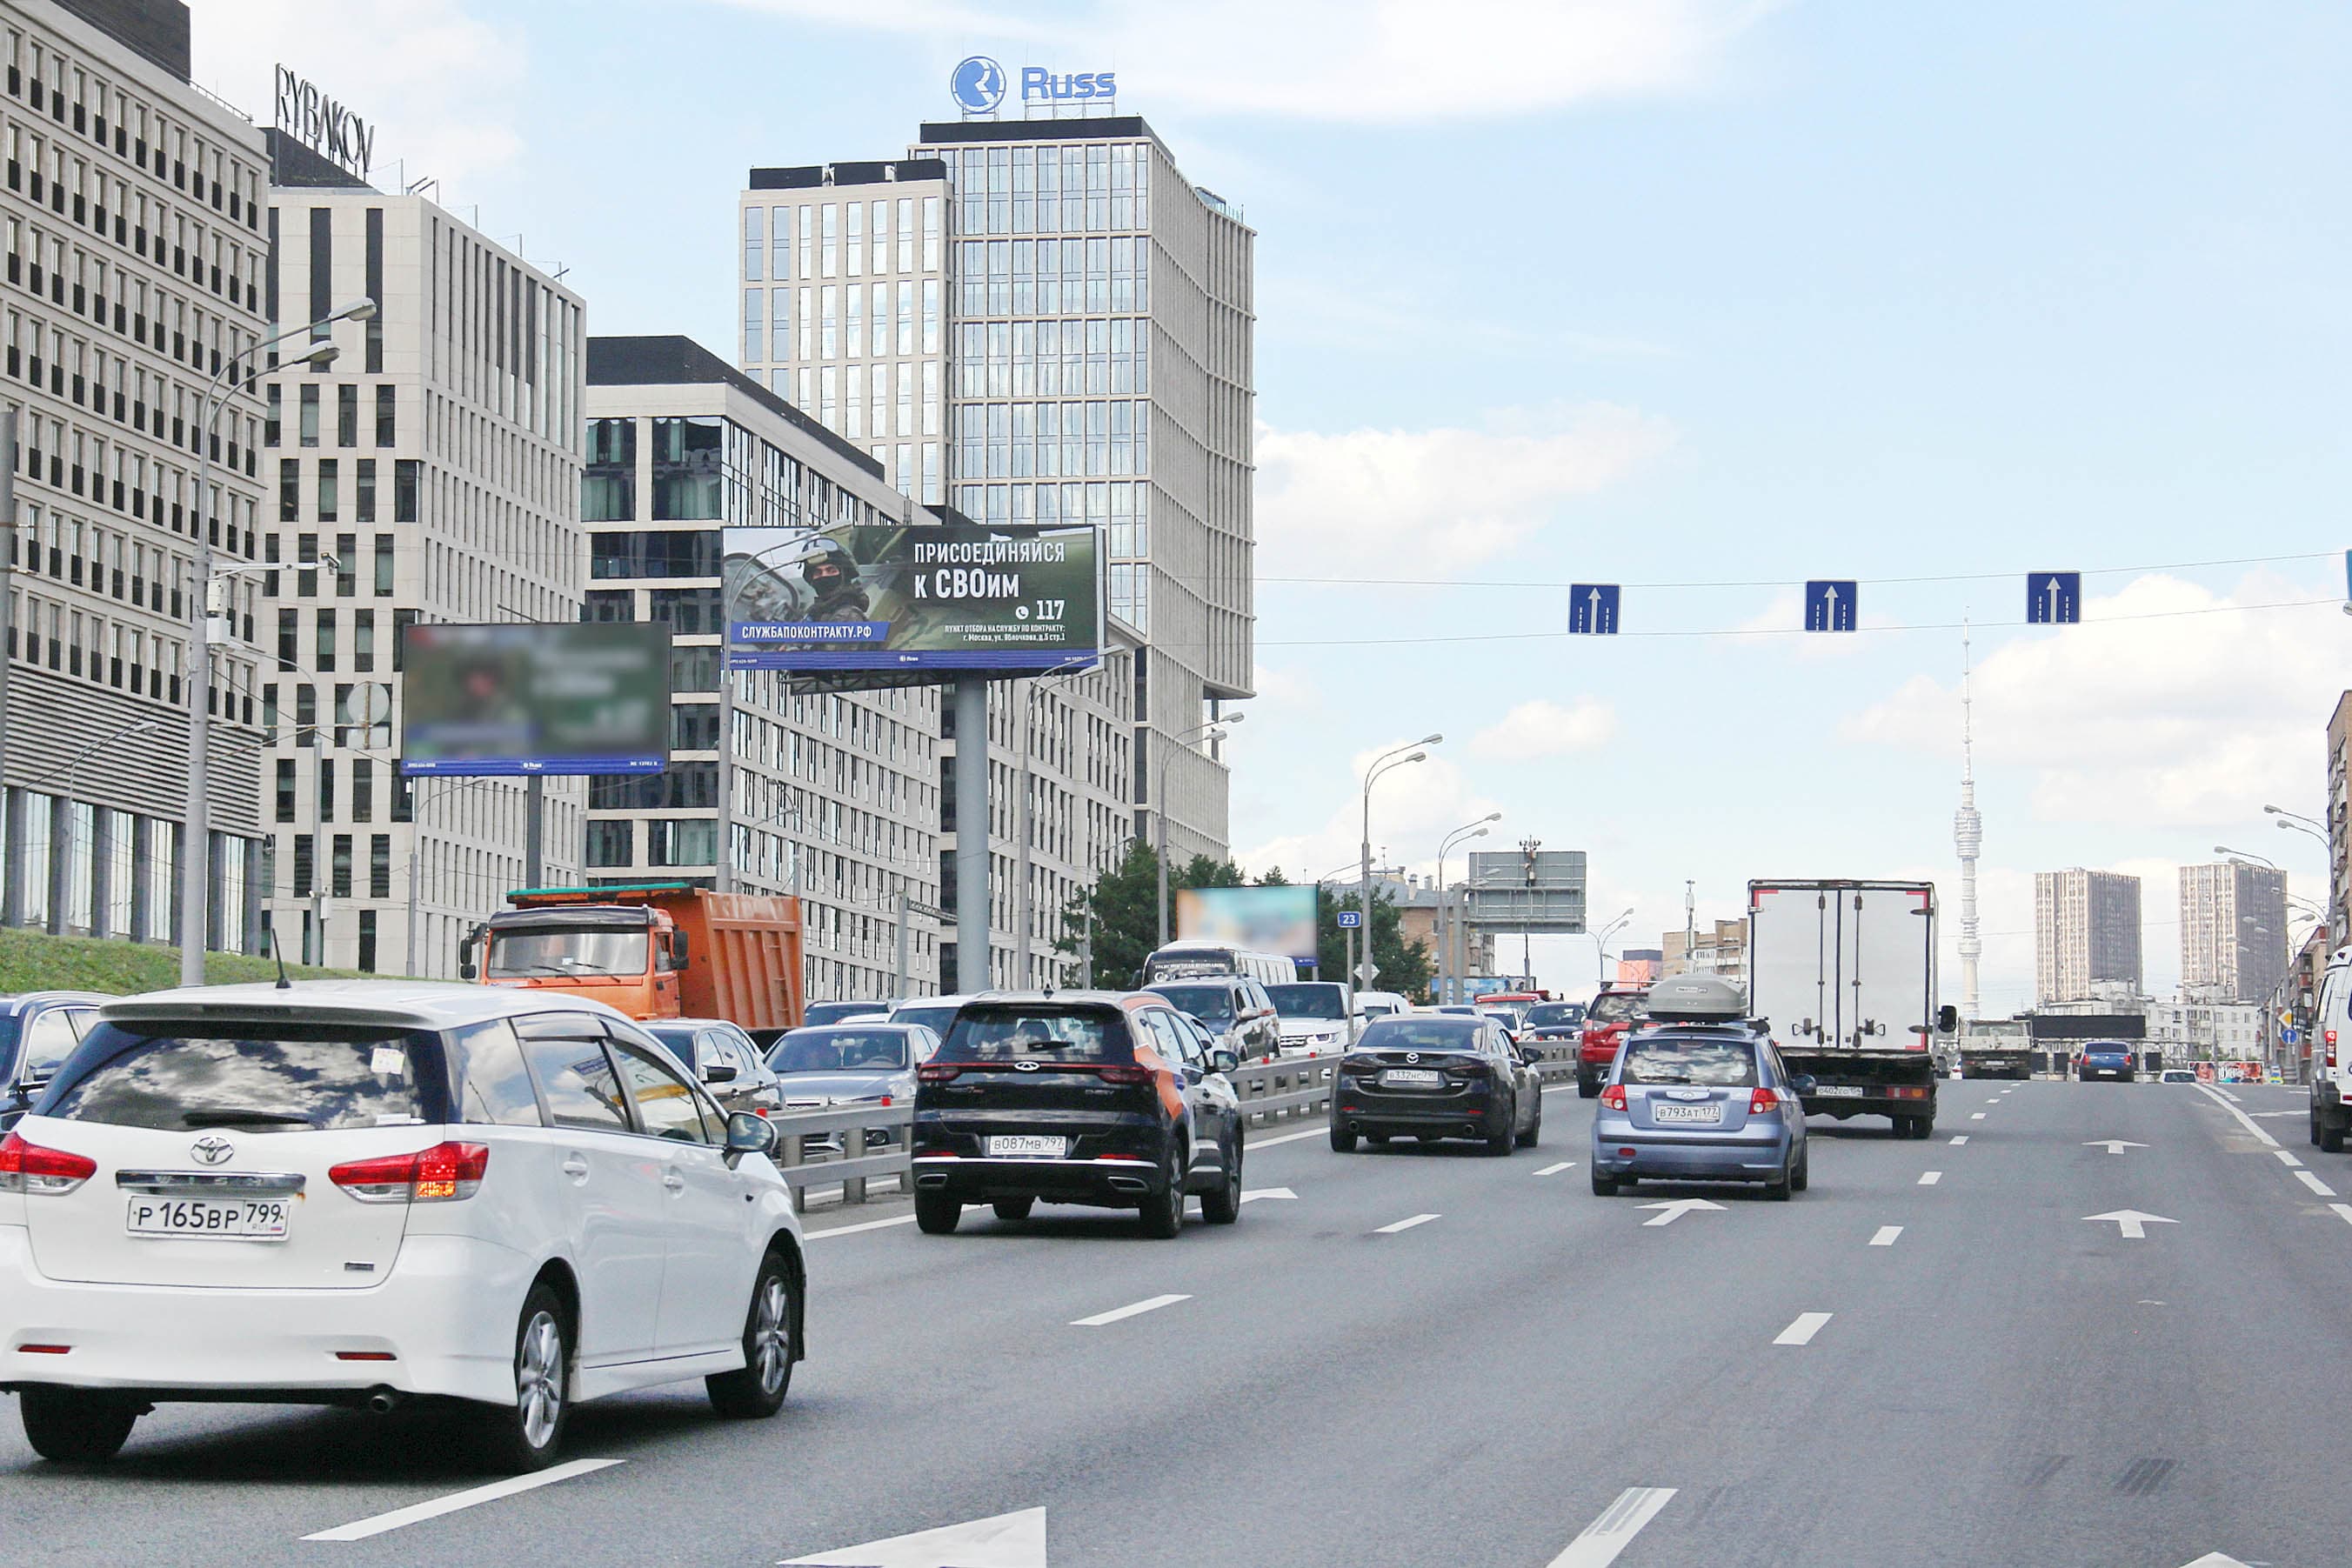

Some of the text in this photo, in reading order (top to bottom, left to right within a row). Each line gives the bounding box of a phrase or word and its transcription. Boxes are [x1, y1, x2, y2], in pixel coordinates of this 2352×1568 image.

[1021, 66, 1117, 100] Russ
[275, 63, 375, 172] RYBAKOV
[914, 538, 1065, 565] ПРИСОЕДИНЯЙСЯ
[1036, 599, 1066, 620] 117
[742, 625, 872, 639] СЛУЖБАПОКОНТРАКТУ.РФ
[965, 624, 986, 633] ОТБОРА
[987, 624, 996, 633] НА
[996, 624, 1021, 633] СЛУЖБУ
[1342, 914, 1356, 924] 23
[1660, 1107, 1717, 1118] В793АТ 177
[993, 1136, 1064, 1151] В087МВ 797
[246, 1203, 282, 1224] 799
